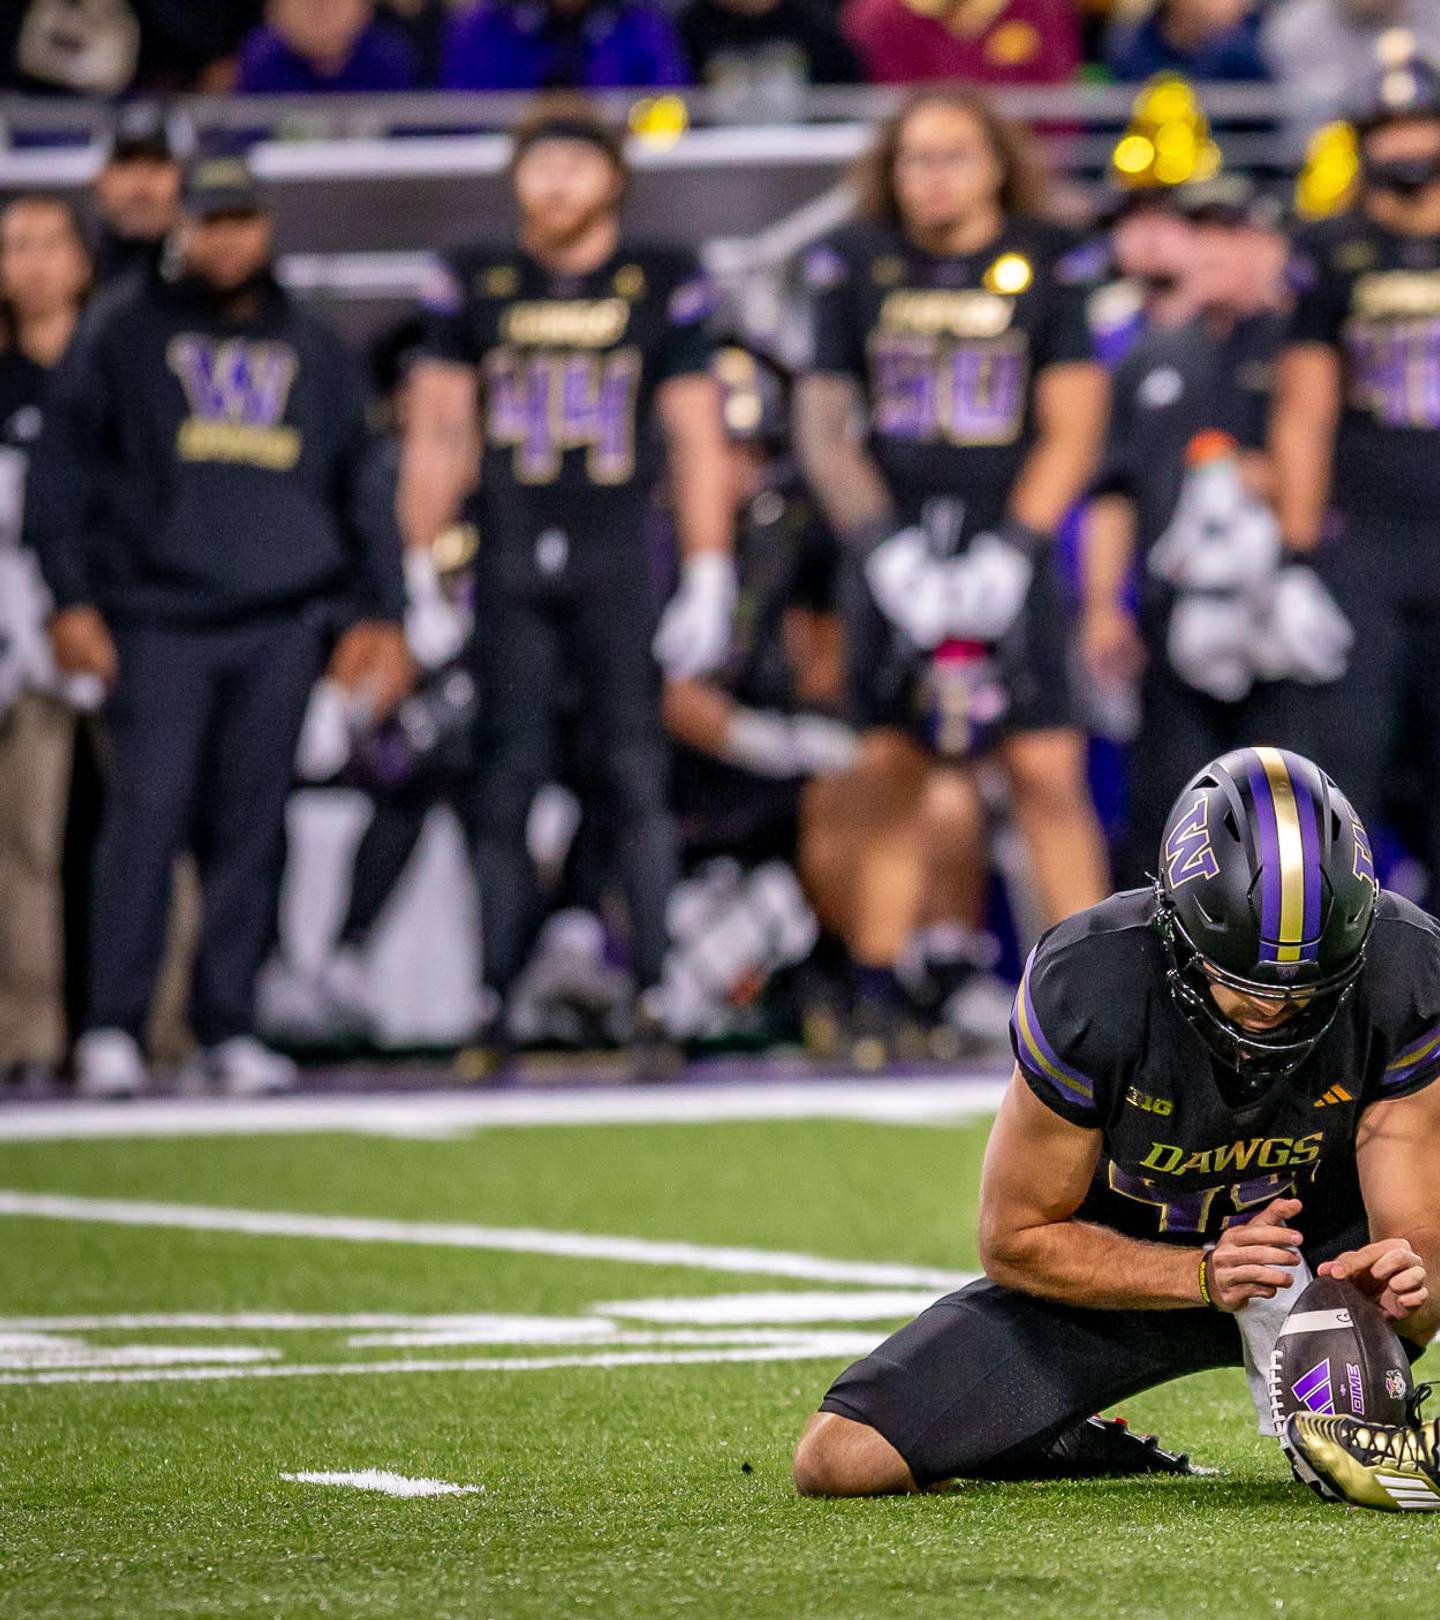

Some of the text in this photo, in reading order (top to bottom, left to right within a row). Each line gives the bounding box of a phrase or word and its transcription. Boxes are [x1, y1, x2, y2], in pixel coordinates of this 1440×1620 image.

[165, 332, 299, 428] W
[481, 347, 643, 486] 44
[1165, 796, 1220, 889] W
[1138, 1131, 1323, 1176] DAWGS
[1108, 1159, 1321, 1233] 4
[1346, 1363, 1365, 1416] DIME
